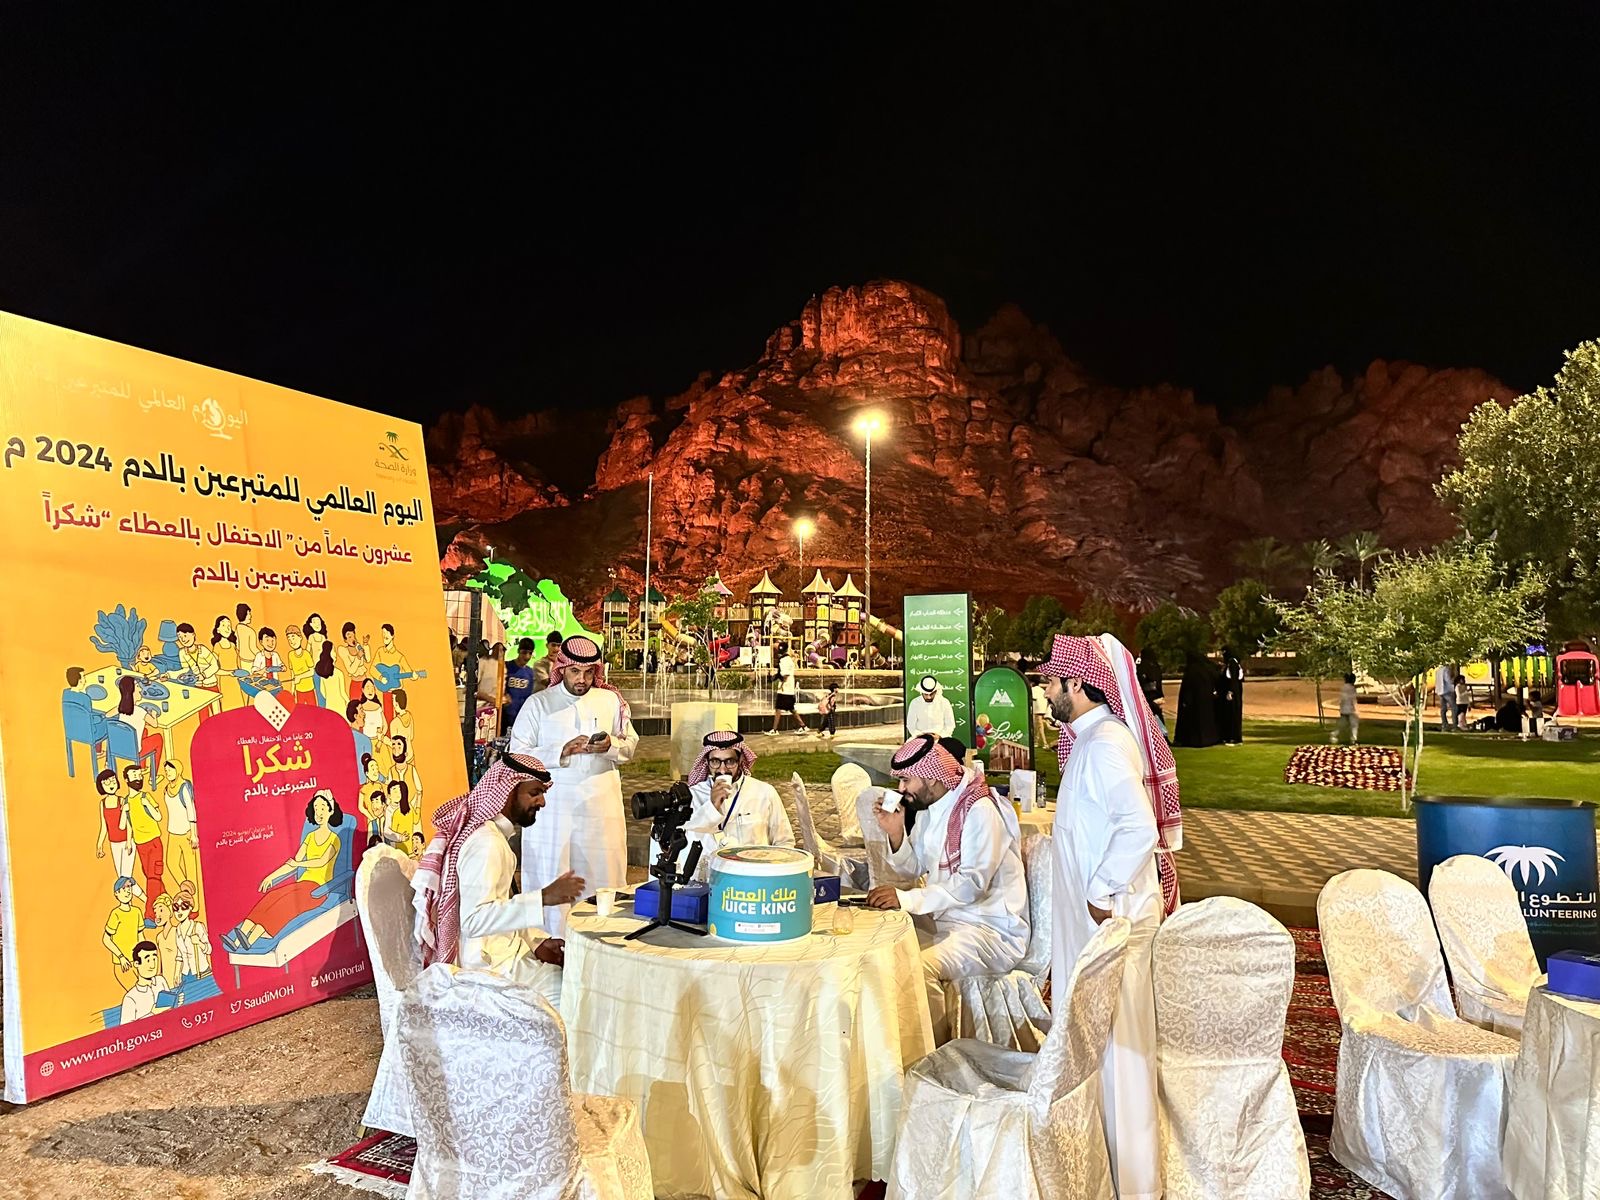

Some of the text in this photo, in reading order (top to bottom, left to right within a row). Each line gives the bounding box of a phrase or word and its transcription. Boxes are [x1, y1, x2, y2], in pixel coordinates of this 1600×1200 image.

[4, 435, 424, 529] اليوم العالمي للمتبرعين بالدم 2024 م
[119, 511, 201, 547] بالعطاء
[207, 522, 283, 549] الاحتفال
[326, 529, 359, 558] عاماً
[362, 543, 413, 563] عشرون
[192, 561, 327, 593] للمتبرعين بالدم
[258, 735, 282, 745] الاحتفال
[304, 732, 313, 740] 20
[242, 740, 313, 784] شكرا
[244, 777, 317, 802] للمتبرعين بالدم
[771, 887, 797, 902] ملك
[1529, 892, 1597, 908] التطوع
[761, 900, 796, 915] KING
[1523, 908, 1597, 919] LUNTEERING
[60, 961, 366, 1070] www.moh.gov.sa 937 SaudiMOH MOHPortal
